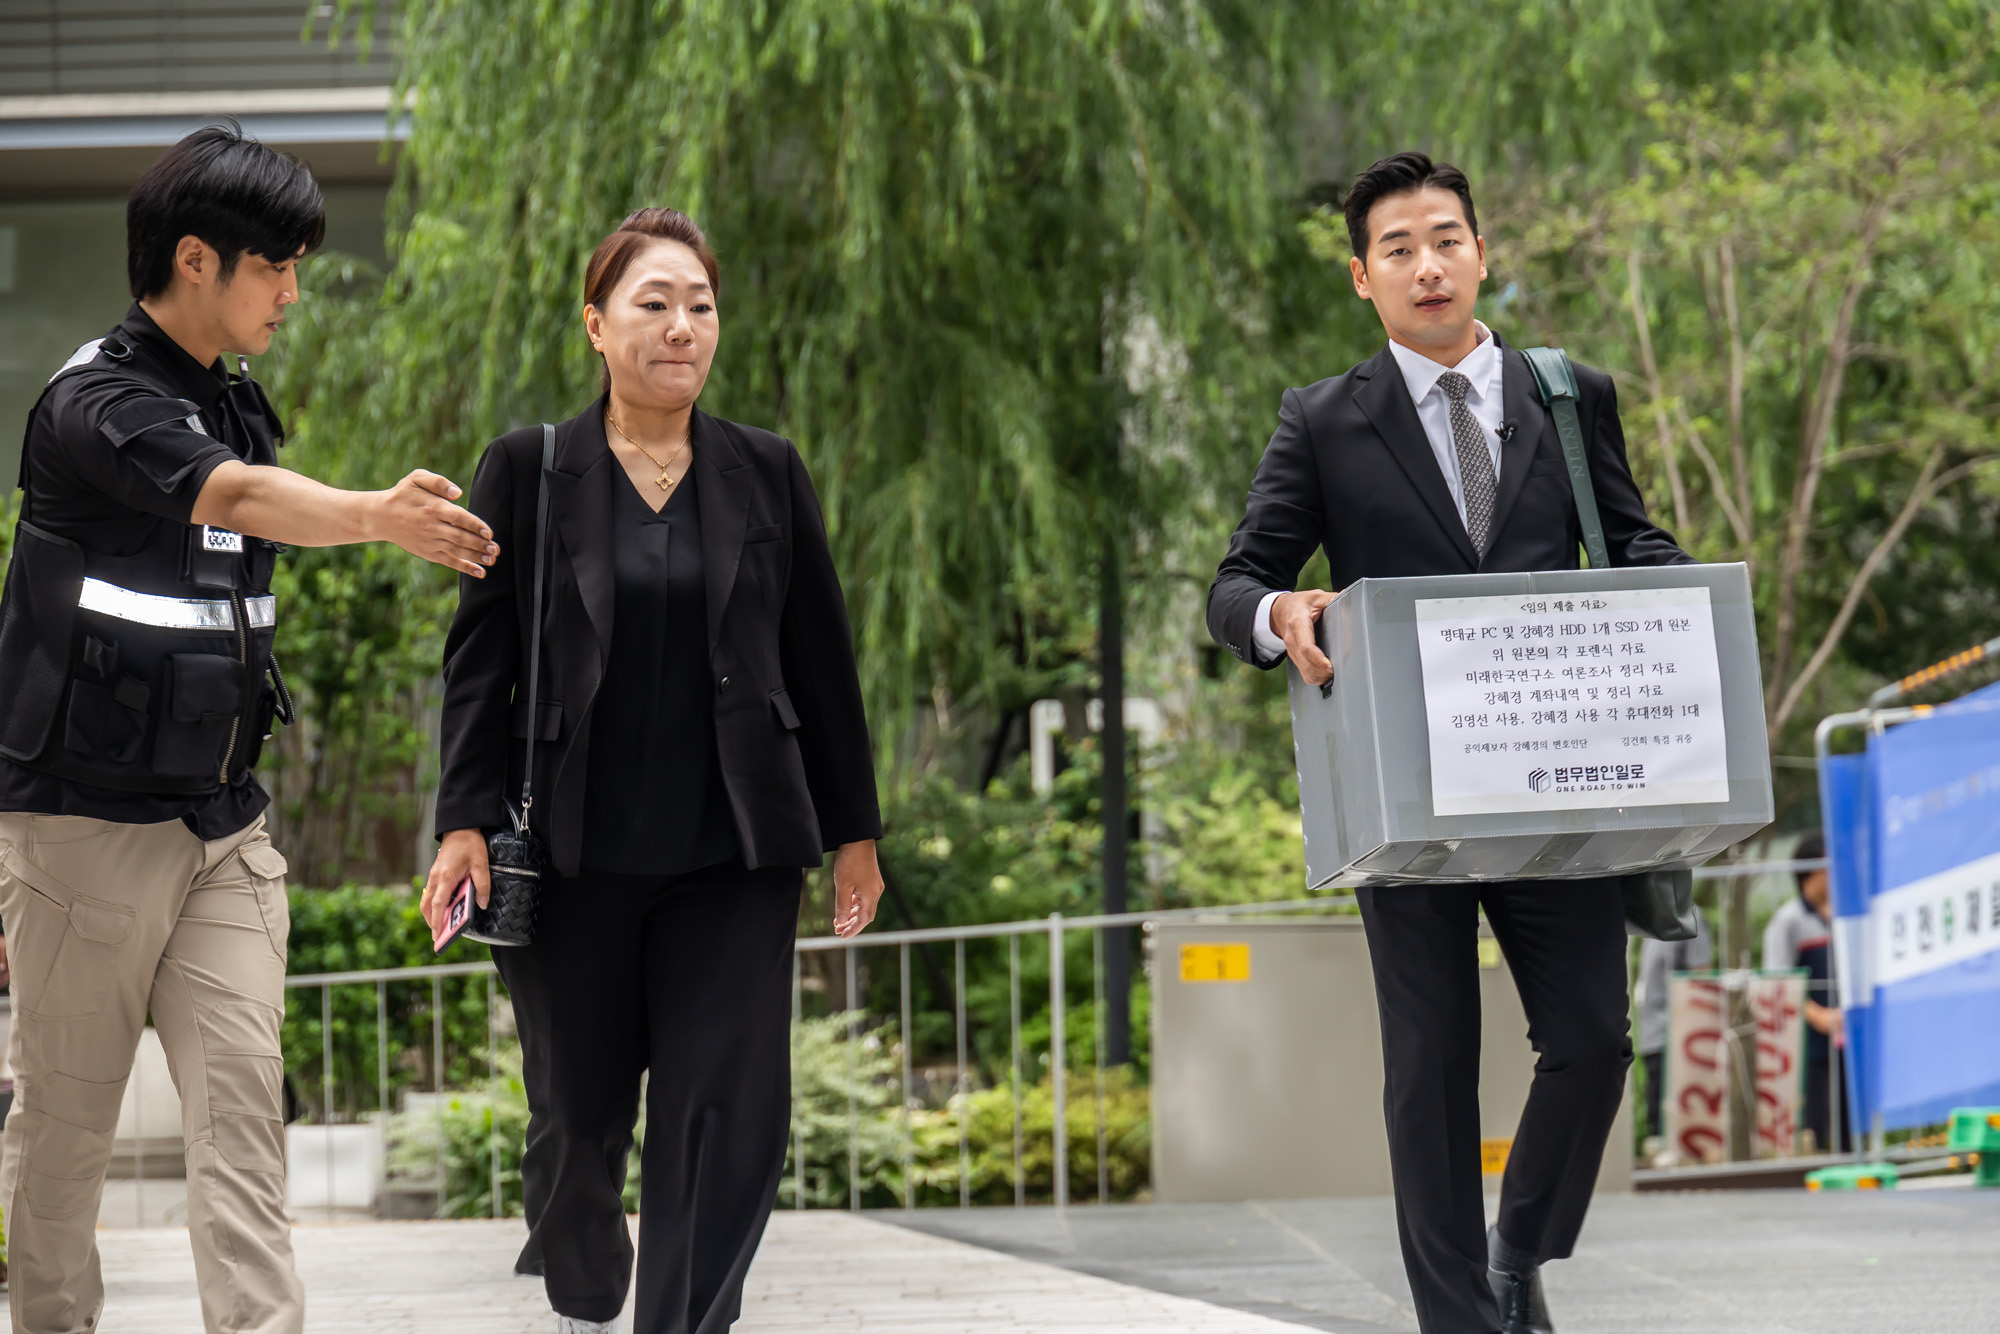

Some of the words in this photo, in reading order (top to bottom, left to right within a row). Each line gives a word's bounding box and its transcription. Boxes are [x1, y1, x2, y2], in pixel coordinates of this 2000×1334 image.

[1521, 602, 1547, 613] <임의
[1553, 601, 1574, 612] 제출
[1581, 600, 1607, 611] 자료>
[1441, 628, 1476, 642] 명태균
[1481, 627, 1497, 638] PC
[1503, 626, 1514, 639] 및
[1520, 624, 1554, 639] 강혜경
[1560, 624, 1586, 635] HDD
[1593, 622, 1610, 635] 1개
[1615, 621, 1639, 633] SSD
[1644, 619, 1663, 632] 2개
[1669, 619, 1691, 631] 원본
[1493, 648, 1503, 661] 위
[1512, 646, 1548, 661] 원본의
[1556, 646, 1568, 659] 각
[1576, 644, 1612, 657] 포렌식
[1621, 642, 1646, 655] 자료
[1466, 669, 1555, 684] 미래한국연구소
[1562, 665, 1612, 679] 여론조사
[1620, 663, 1644, 677] 정리
[1652, 662, 1677, 675] 자료
[1485, 691, 1521, 705] 강혜경
[1530, 688, 1579, 702] 계좌내역
[1587, 687, 1599, 700] 및
[1607, 686, 1630, 699] 정리
[1639, 685, 1663, 697] 자료
[1452, 714, 1488, 728] 김영선
[1531, 710, 1567, 725] 강혜경
[1575, 709, 1600, 722] 사용
[1607, 708, 1618, 721] 각
[1625, 705, 1674, 720] 휴대전화
[1682, 704, 1699, 717] 1대
[1464, 742, 1507, 753] 공익제보자
[1513, 740, 1547, 751] 강혜경의
[1553, 739, 1587, 749] 변호인단
[1622, 736, 1647, 746] 김건희
[1676, 734, 1692, 743] 귀중
[1555, 764, 1645, 782] 법무법인일로
